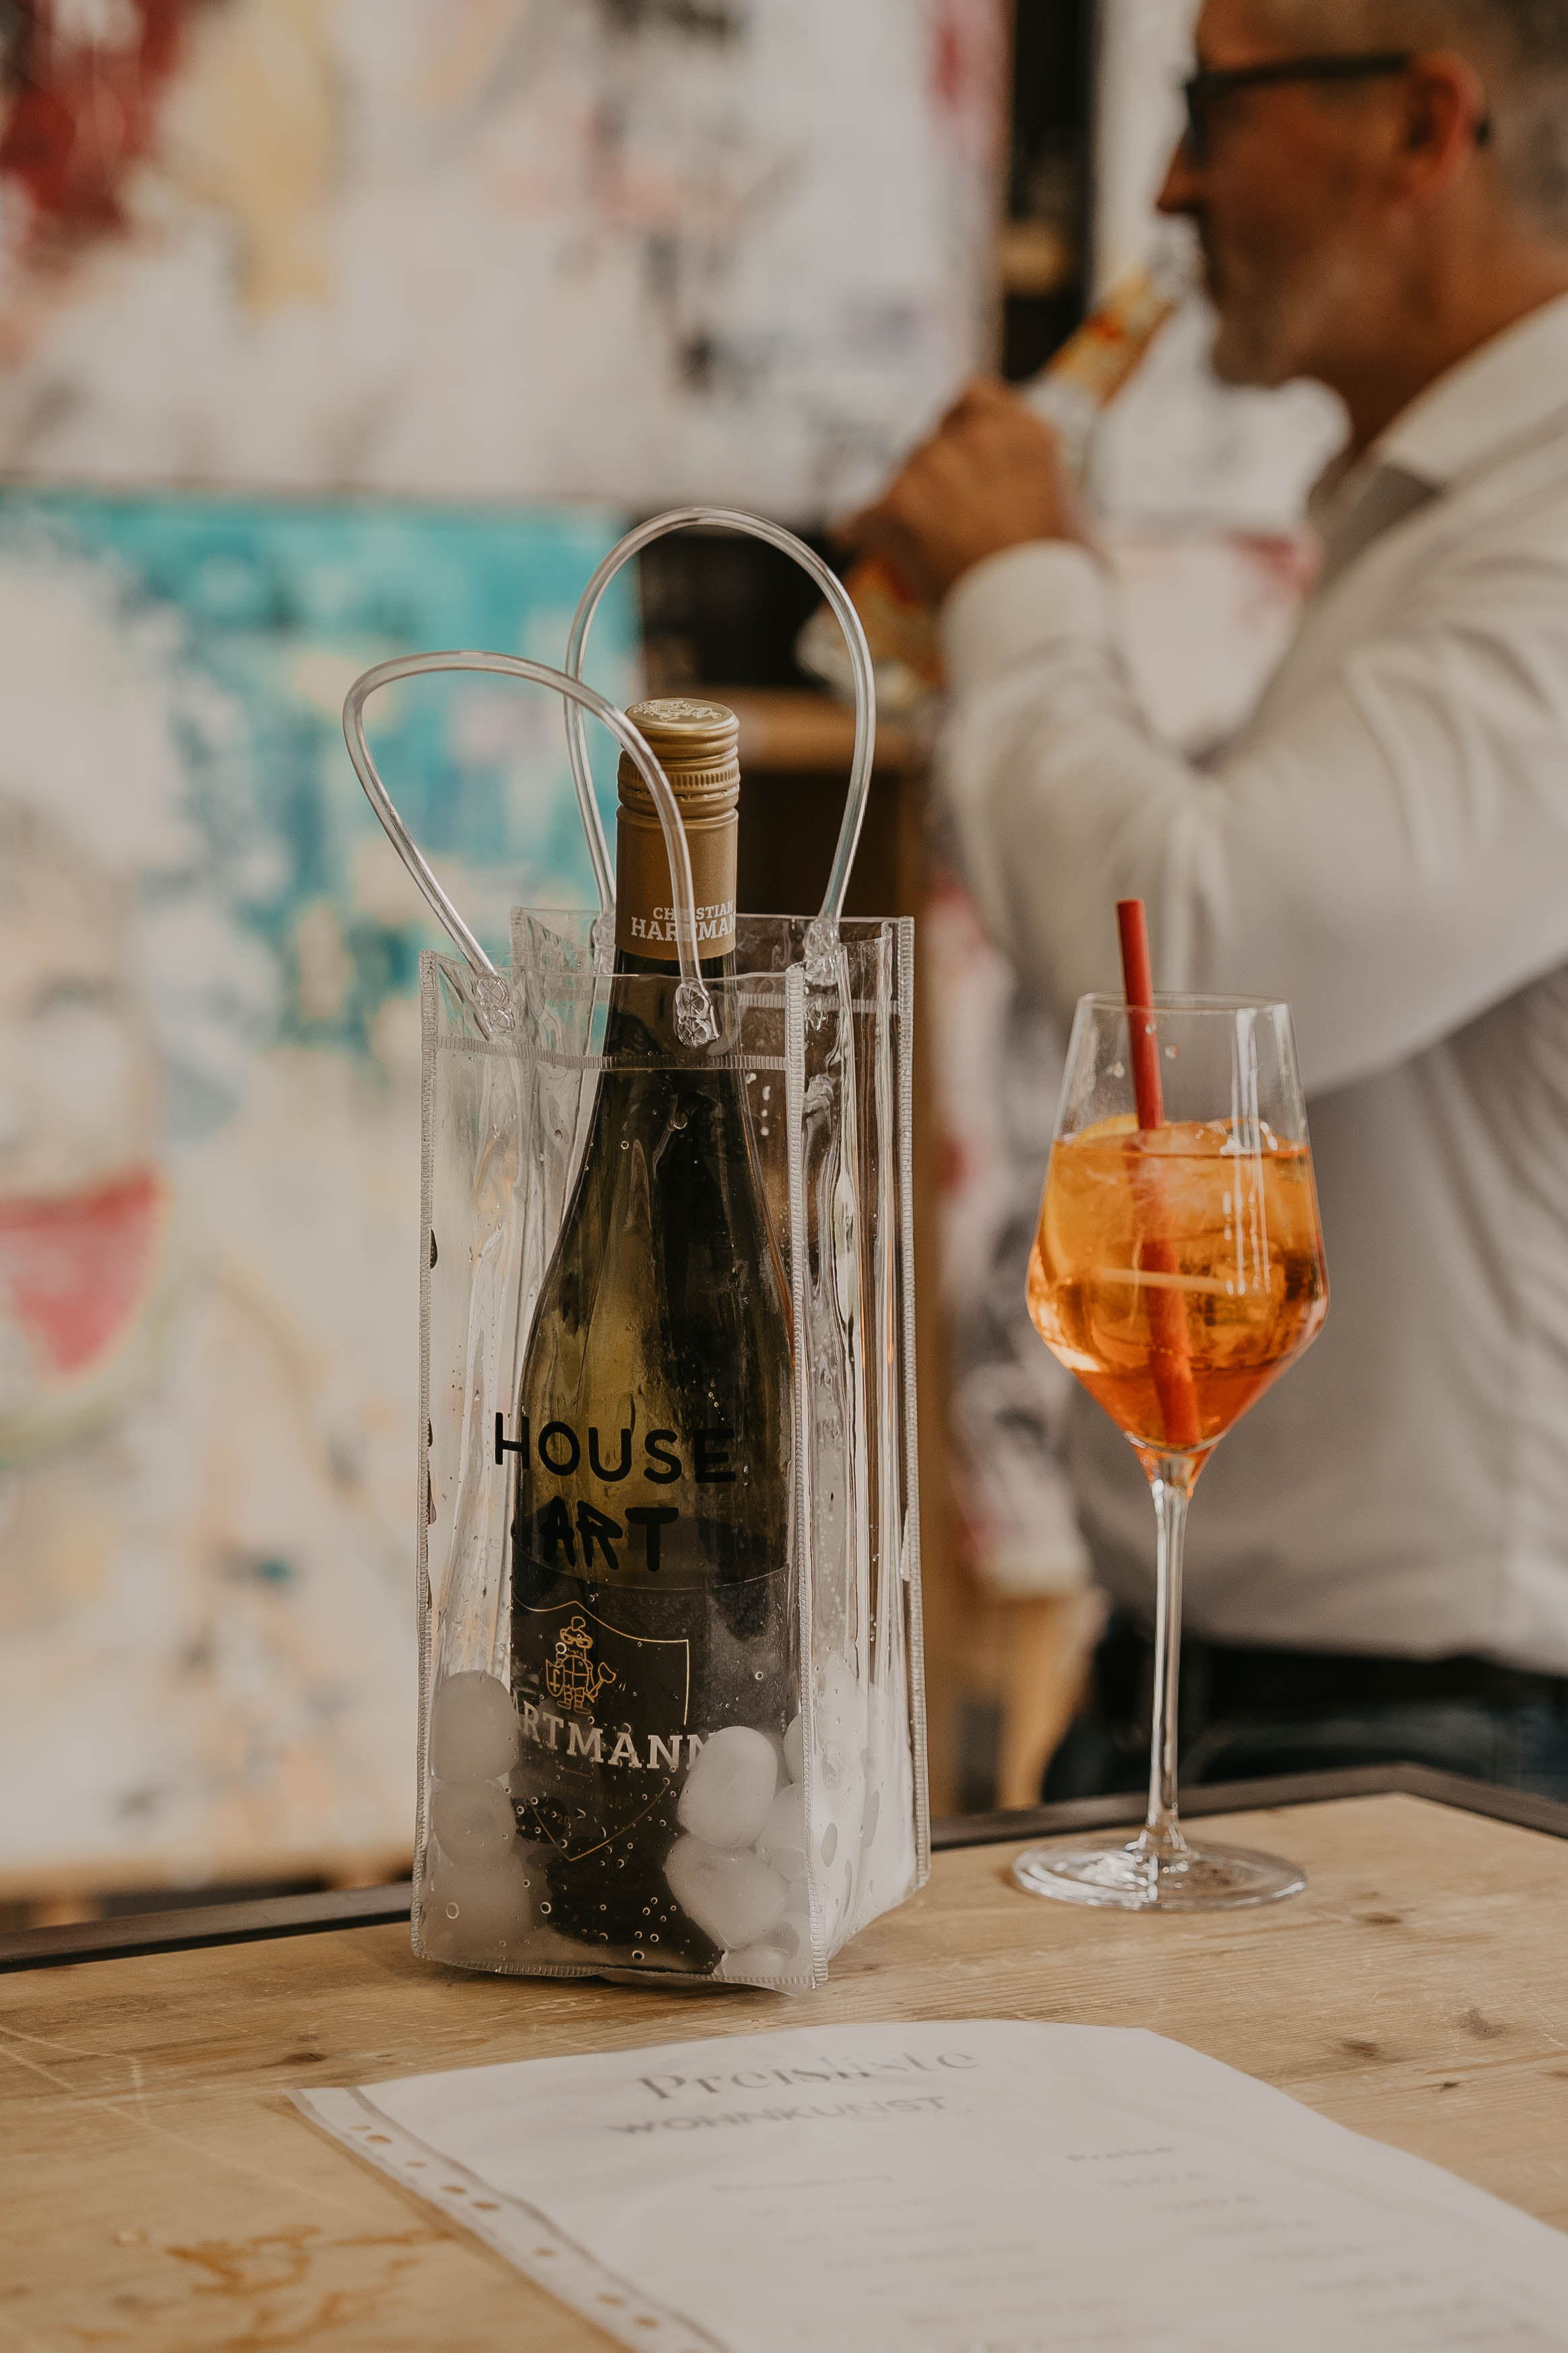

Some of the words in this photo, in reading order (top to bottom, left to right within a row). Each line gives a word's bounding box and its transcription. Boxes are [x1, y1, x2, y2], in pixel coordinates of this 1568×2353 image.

[653, 900, 733, 921] CHSTIAN
[495, 1412, 736, 1485] HOUSE
[540, 1495, 679, 1572] ART
